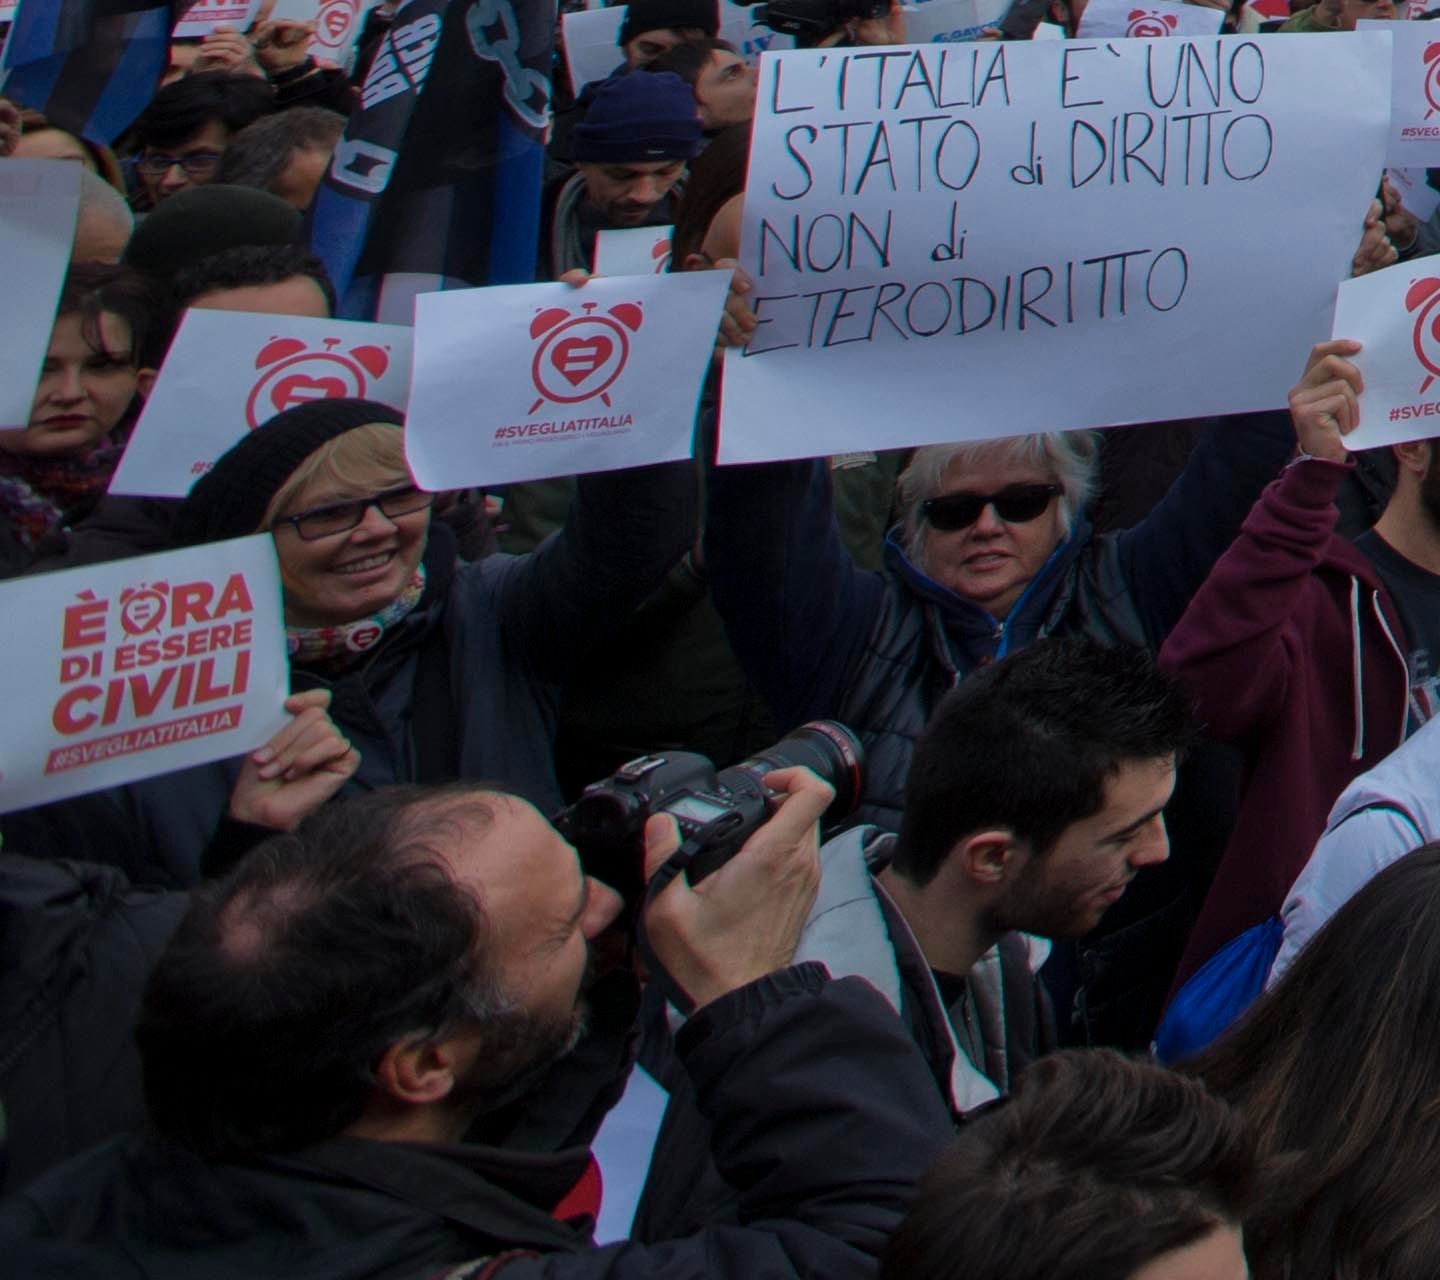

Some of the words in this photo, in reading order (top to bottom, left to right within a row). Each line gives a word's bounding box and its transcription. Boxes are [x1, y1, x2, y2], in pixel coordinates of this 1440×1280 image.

[771, 42, 1012, 115] L'ITALIA
[1147, 40, 1267, 109] UNO
[771, 115, 981, 201] STATO
[1009, 120, 1045, 188] di
[1069, 109, 1274, 190] DIRITTO
[758, 209, 892, 276] NON
[930, 201, 968, 264] di
[742, 246, 1189, 358] ETERODIRITTO
[493, 413, 634, 441] #SVEGLIATITALIA
[63, 591, 109, 650] È
[119, 572, 254, 641] ORA
[60, 649, 102, 684] DI
[113, 618, 253, 674] ESSERE
[51, 648, 251, 738] CIVILI
[53, 711, 233, 770] #SVEGLIATITALIA
